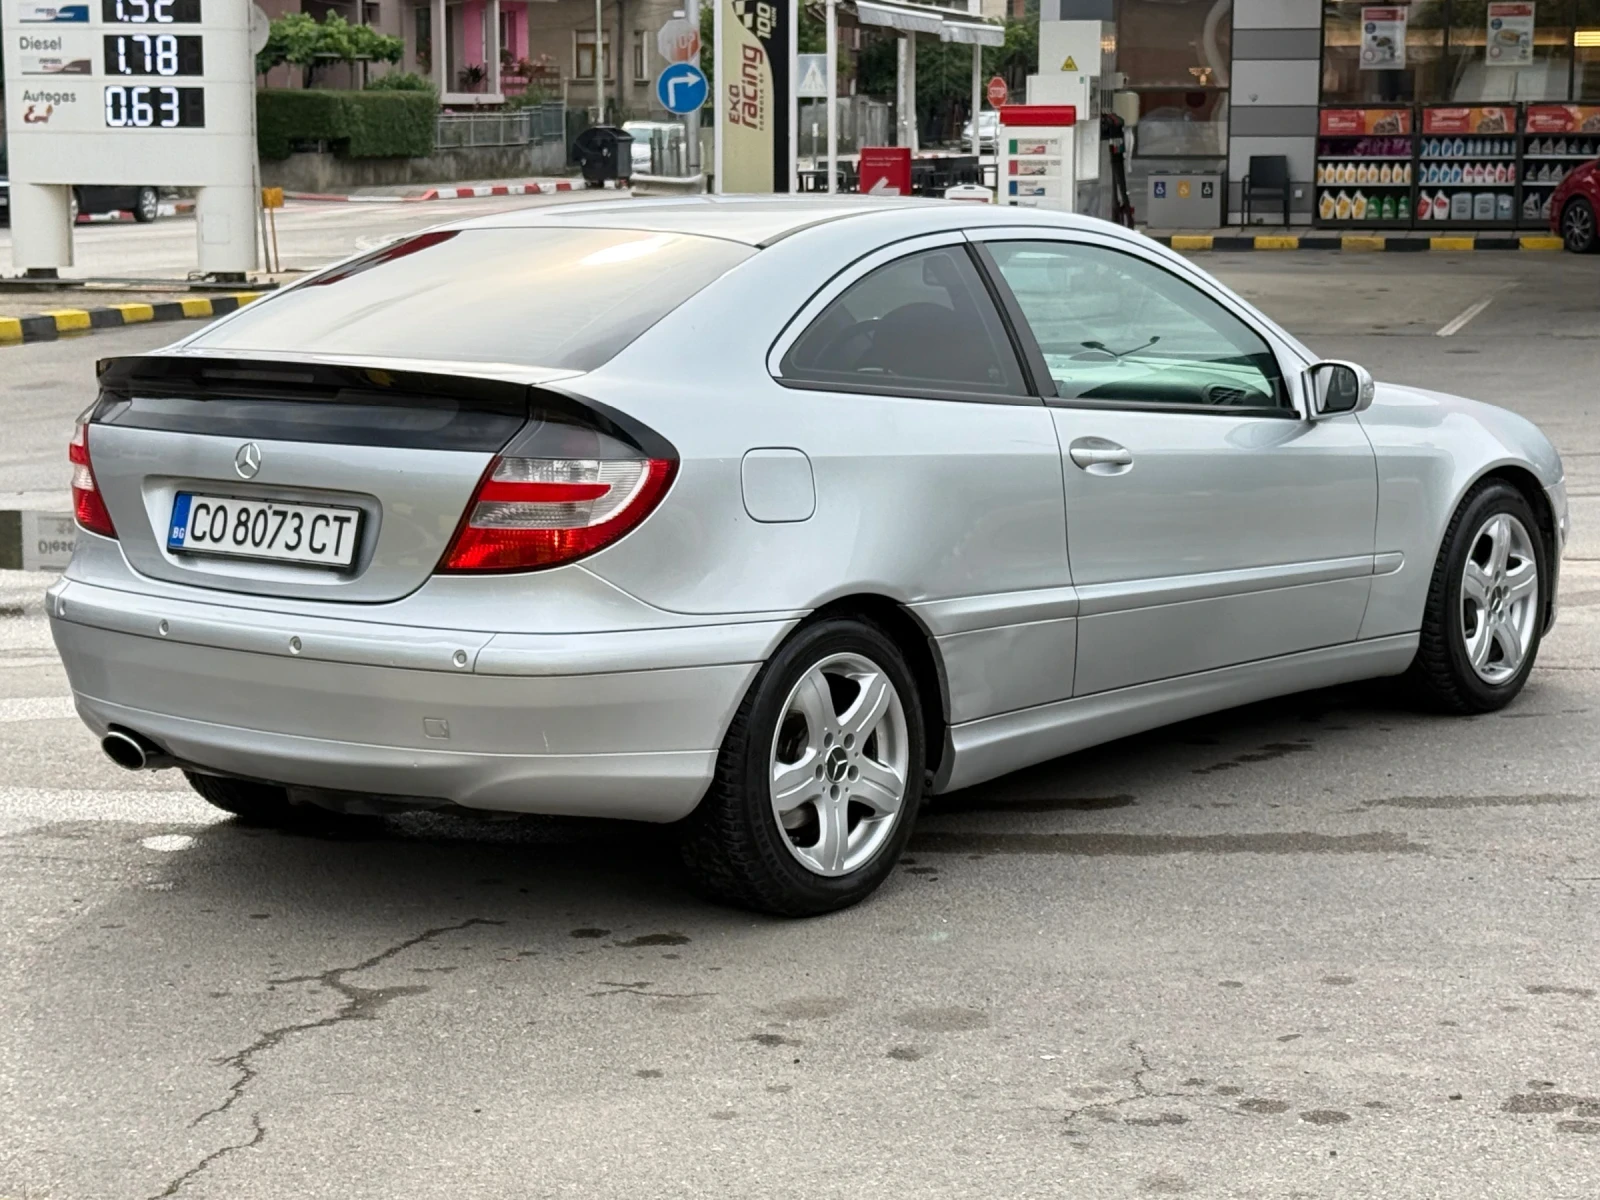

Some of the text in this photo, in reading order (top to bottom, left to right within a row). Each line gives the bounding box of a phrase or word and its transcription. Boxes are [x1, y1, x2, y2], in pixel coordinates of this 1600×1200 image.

[115, 0, 174, 23] 1.52
[756, 1, 772, 39] 100
[19, 36, 62, 51] Diesel
[117, 33, 179, 75] 1.78
[23, 90, 77, 106] Autogas
[742, 44, 764, 130] racing
[105, 86, 180, 127] 0.63
[172, 527, 185, 540] BG
[232, 506, 305, 552] 8073
